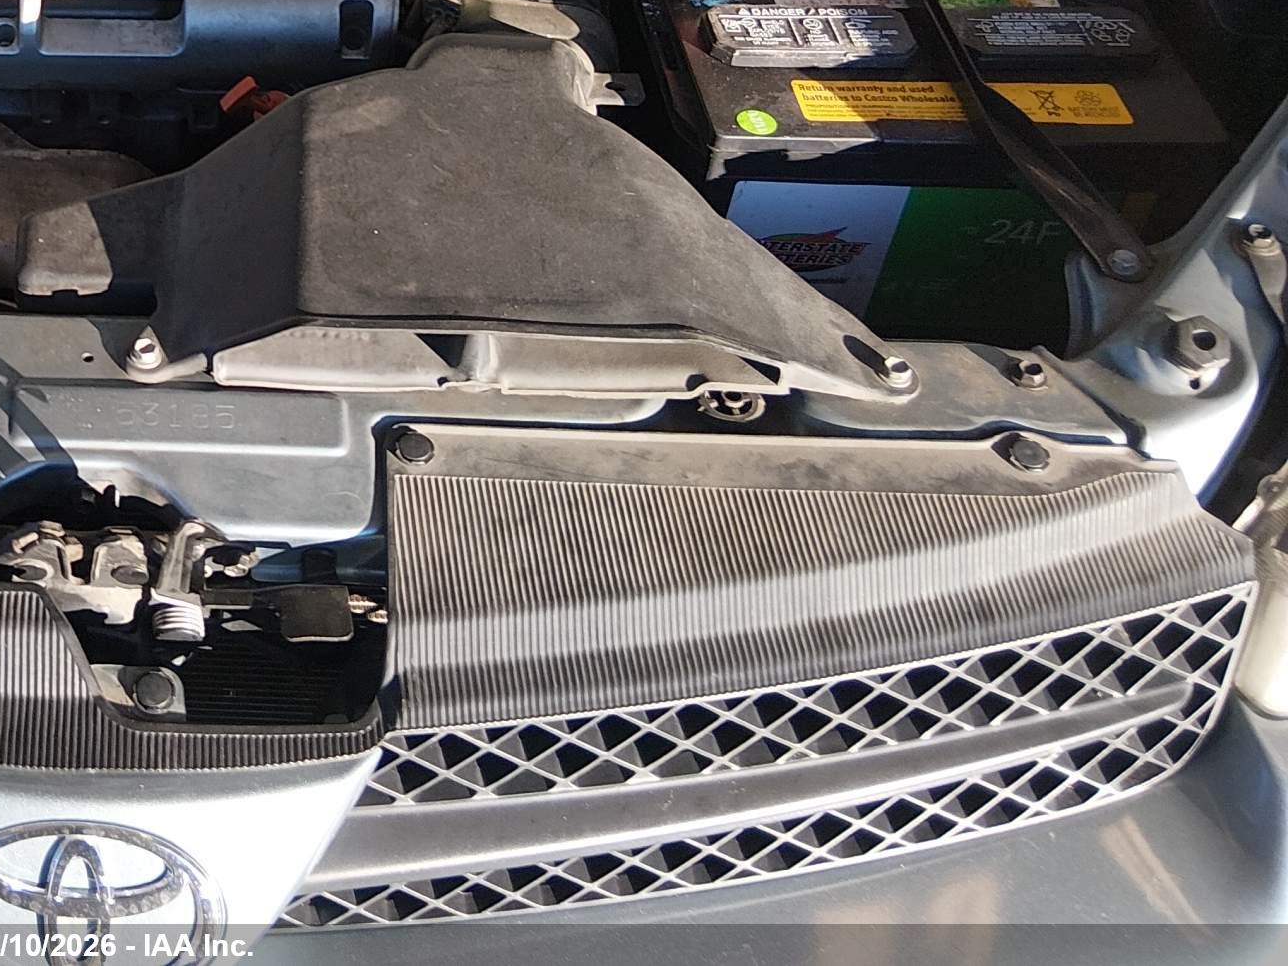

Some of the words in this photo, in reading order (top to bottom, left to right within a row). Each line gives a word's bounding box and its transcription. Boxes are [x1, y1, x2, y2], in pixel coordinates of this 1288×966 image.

[751, 7, 806, 16] DANGER
[818, 8, 868, 17] POISON
[798, 83, 834, 93] Return
[836, 85, 884, 94] warranty
[886, 85, 906, 93] and
[908, 85, 935, 93] used
[802, 93, 849, 102] batteries
[851, 94, 862, 102] to
[899, 95, 956, 103] Wholesale
